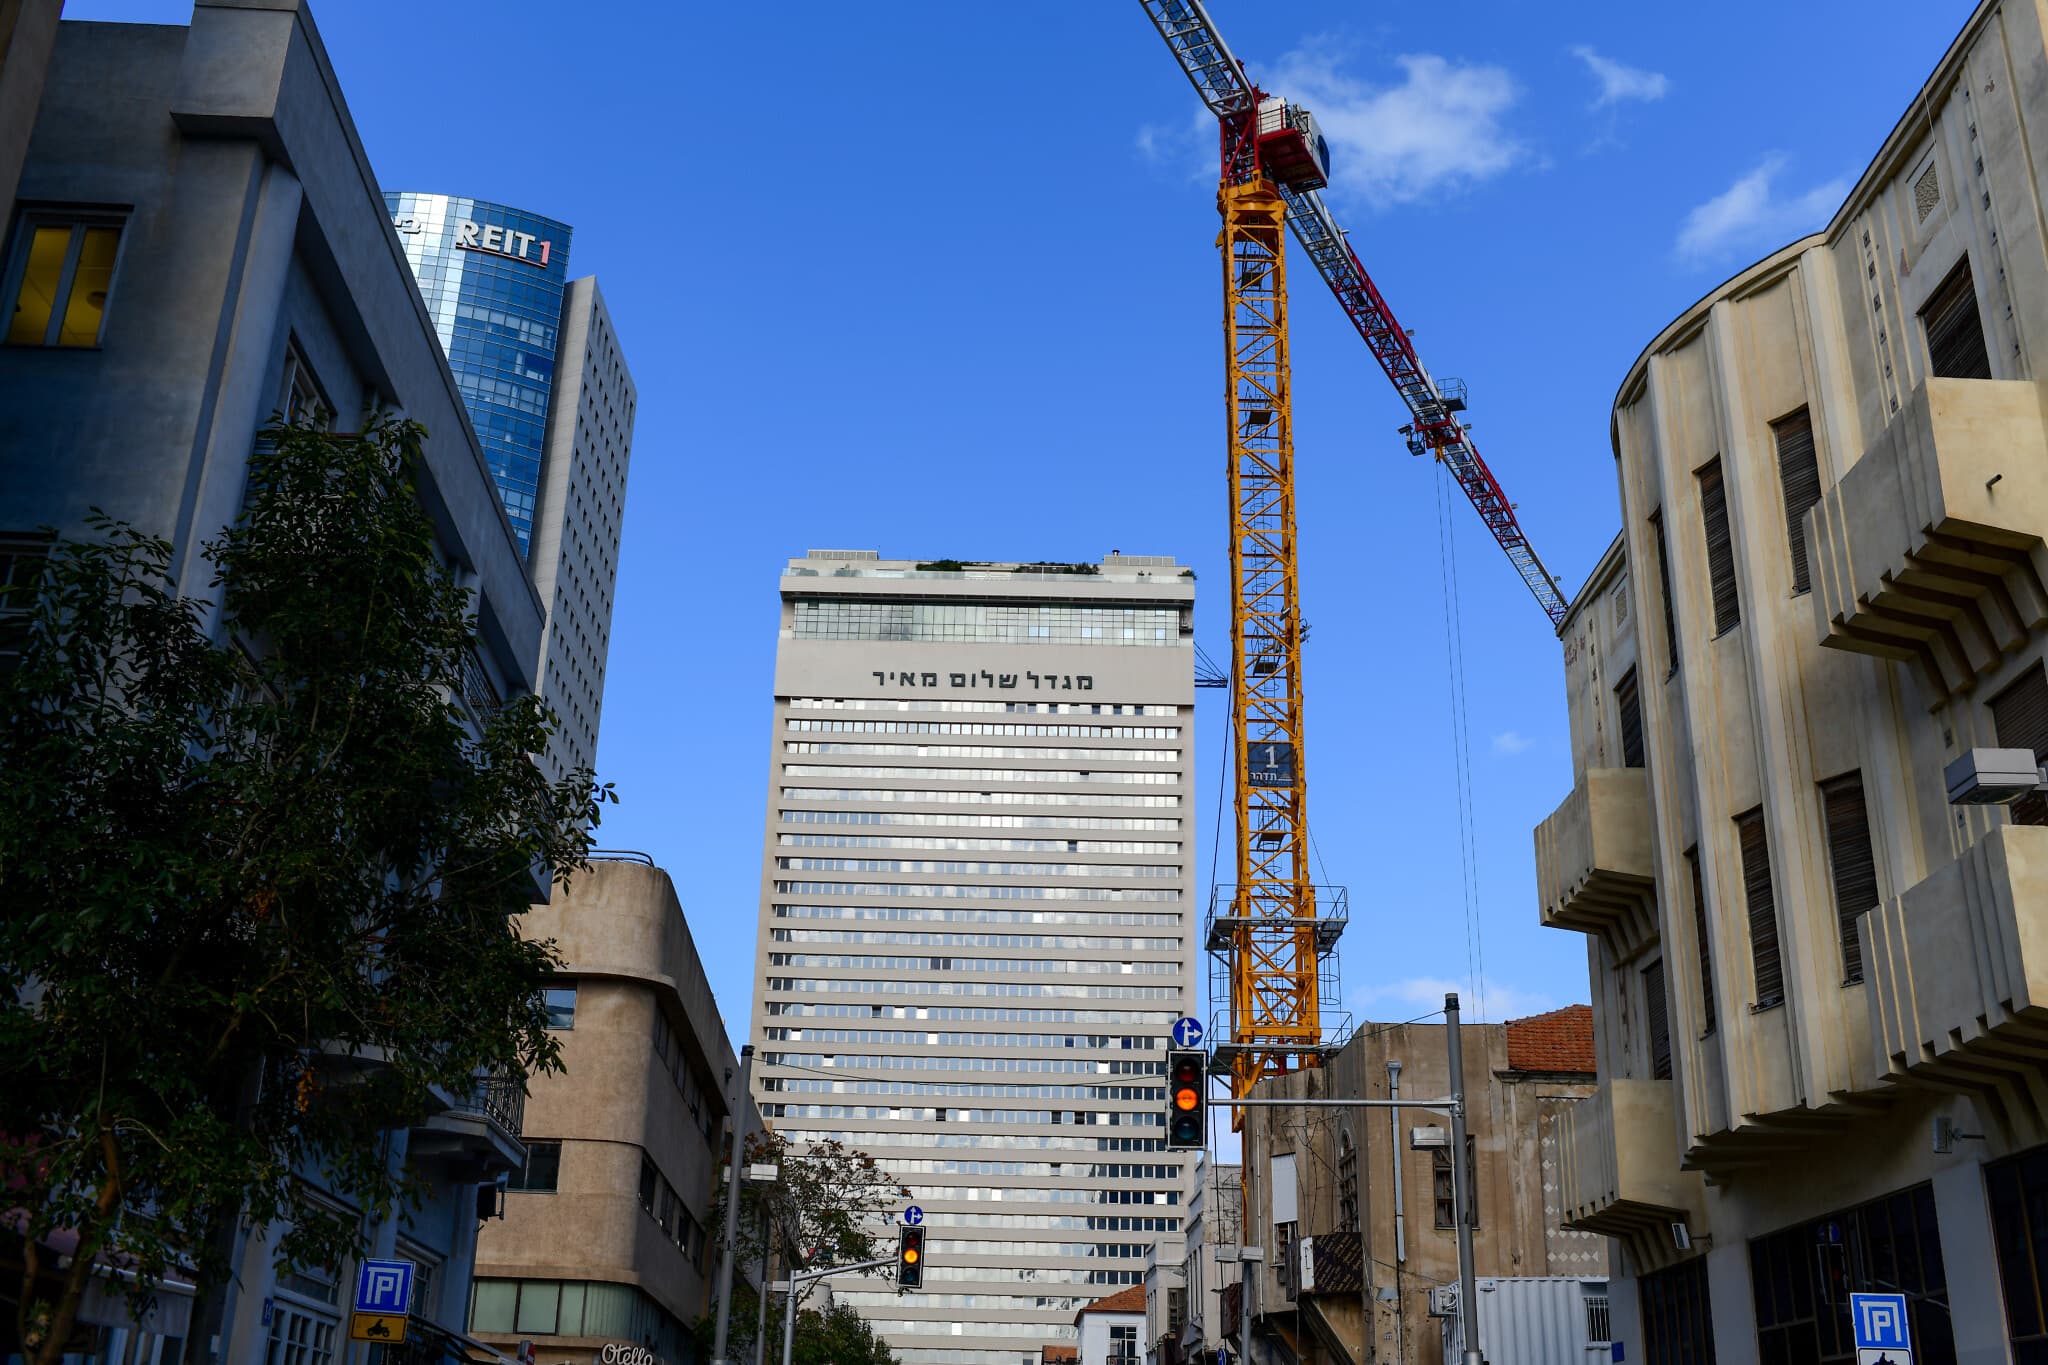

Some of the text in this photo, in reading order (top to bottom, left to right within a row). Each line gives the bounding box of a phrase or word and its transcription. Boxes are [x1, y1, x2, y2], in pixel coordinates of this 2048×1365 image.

[872, 670, 1093, 690] מגדל שלום מאיר
[1265, 745, 1279, 768] 1
